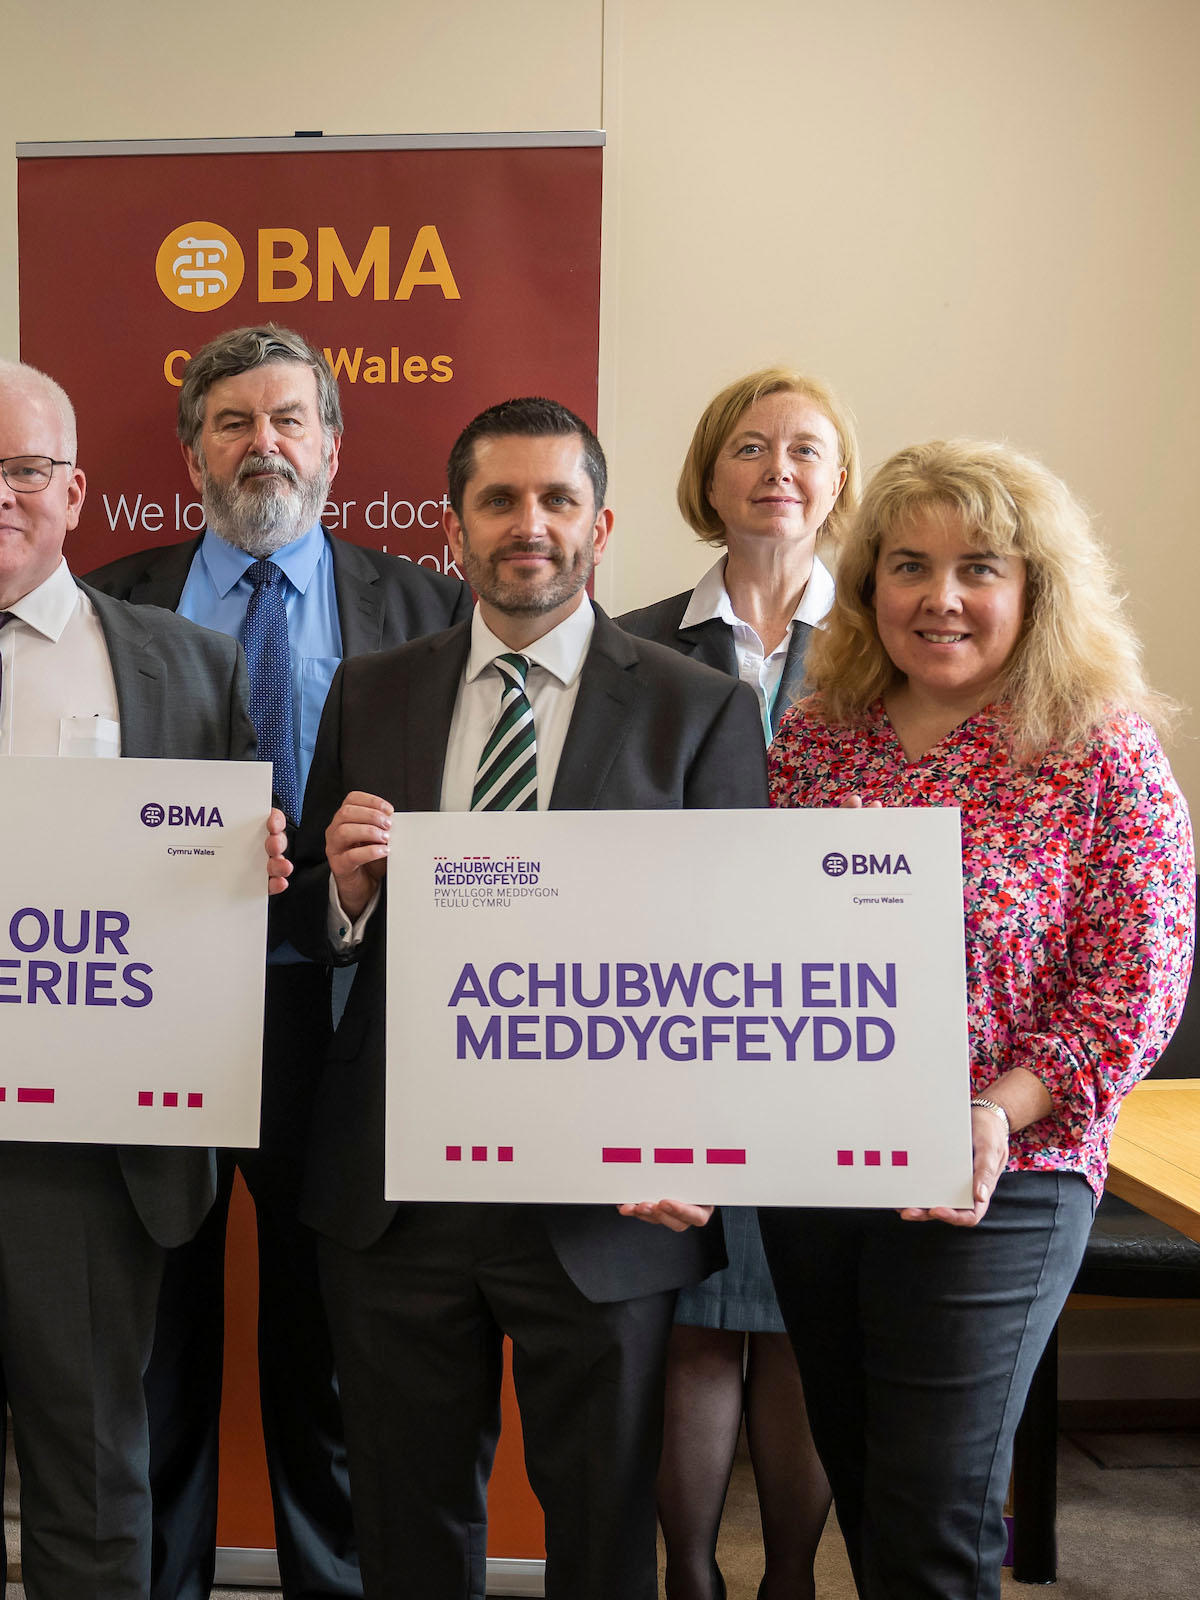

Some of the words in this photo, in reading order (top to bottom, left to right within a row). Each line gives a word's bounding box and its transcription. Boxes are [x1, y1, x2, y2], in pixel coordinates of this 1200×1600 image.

[257, 225, 461, 303] BMA
[323, 347, 454, 384] Wales
[102, 494, 164, 531] We
[175, 493, 206, 531] lo
[168, 805, 224, 827] BMA
[167, 847, 192, 856] Cymru
[193, 848, 215, 856] Wales
[434, 862, 514, 874] ACHUBWCH
[517, 861, 540, 873] EIN
[851, 854, 912, 875] BMA
[435, 874, 539, 885] MEDDYGFEYDD
[434, 888, 493, 898] PWYLLGOR
[497, 887, 559, 897] MEDDYGON
[434, 898, 469, 908] TEULU
[472, 898, 511, 907] CYMRU
[853, 896, 880, 905] Cymru
[880, 896, 904, 904] Wales
[9, 907, 130, 955] OUR
[447, 961, 783, 1009] ACHUBWCH
[801, 962, 898, 1009] EIN
[456, 1014, 897, 1063] MEDDYGFEYDD
